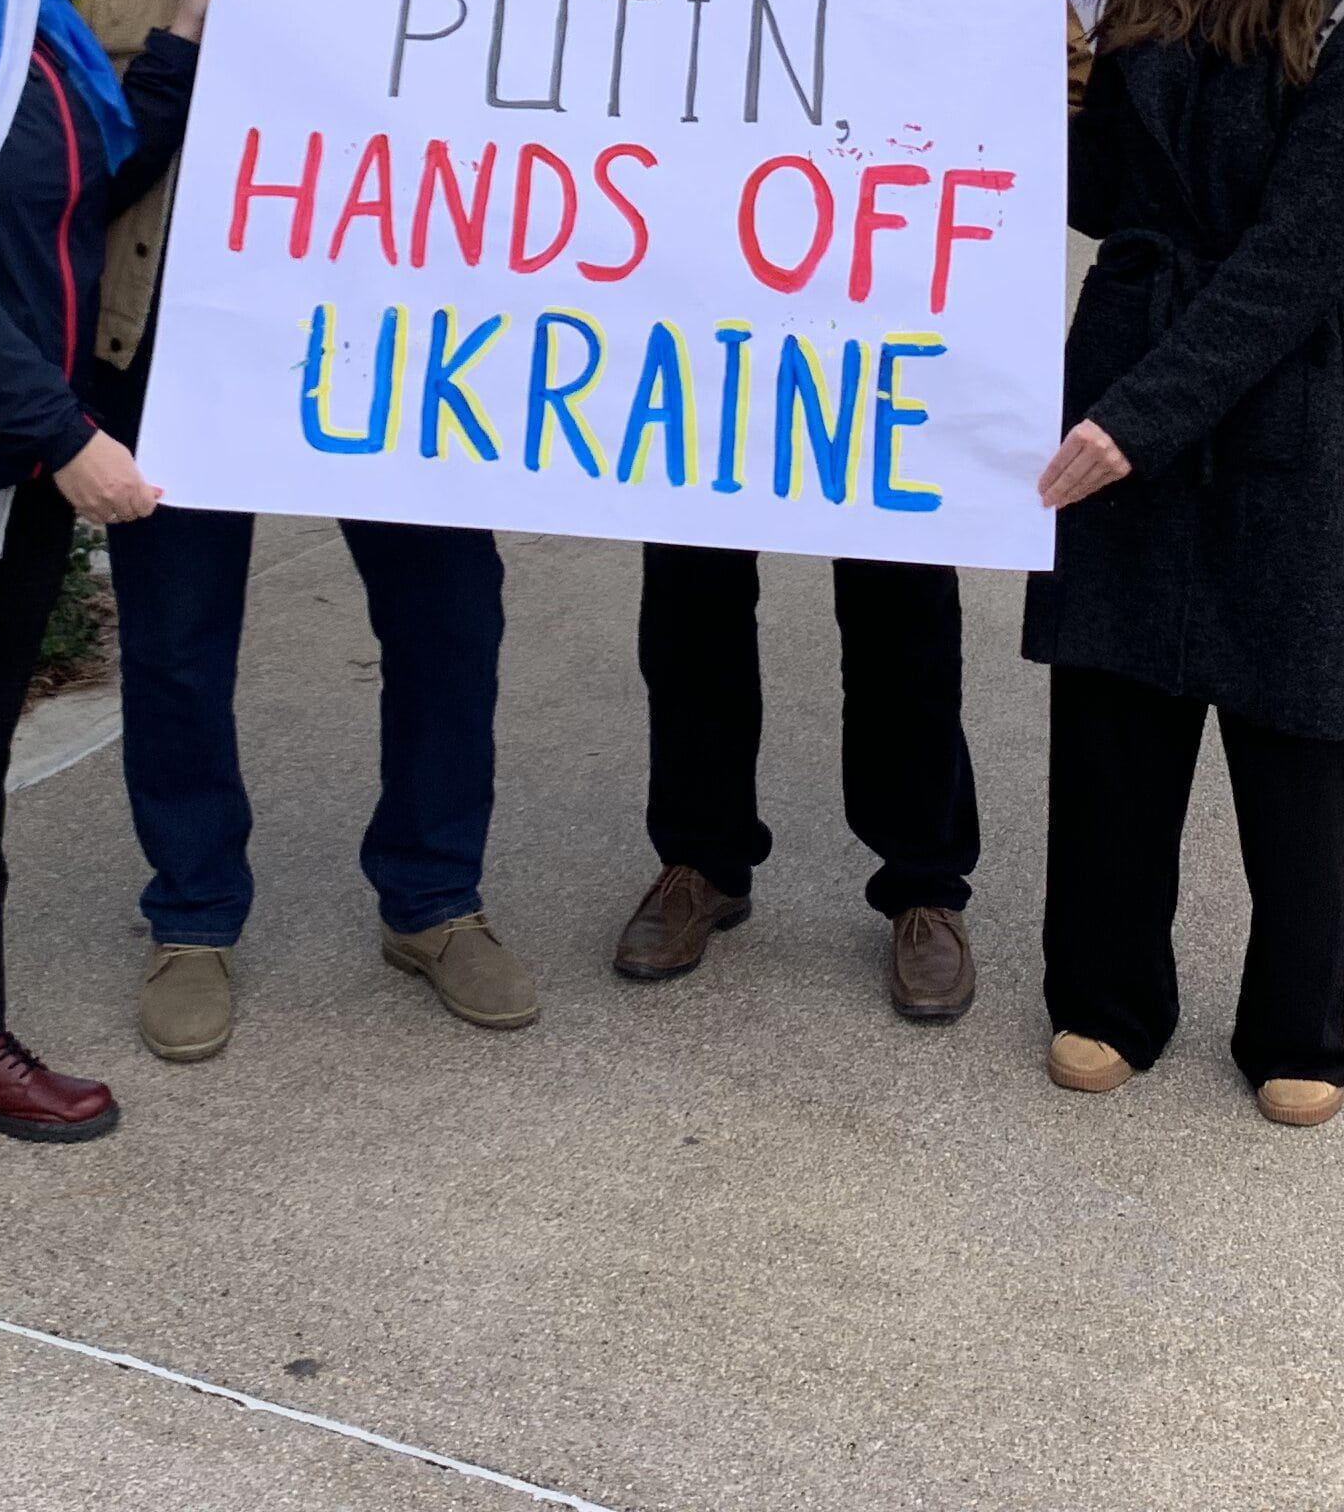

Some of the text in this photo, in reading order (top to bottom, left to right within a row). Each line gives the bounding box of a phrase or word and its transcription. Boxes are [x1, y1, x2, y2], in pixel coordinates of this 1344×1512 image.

[227, 126, 1017, 314] HANDS OFF
[297, 302, 950, 512] UKRAINE
